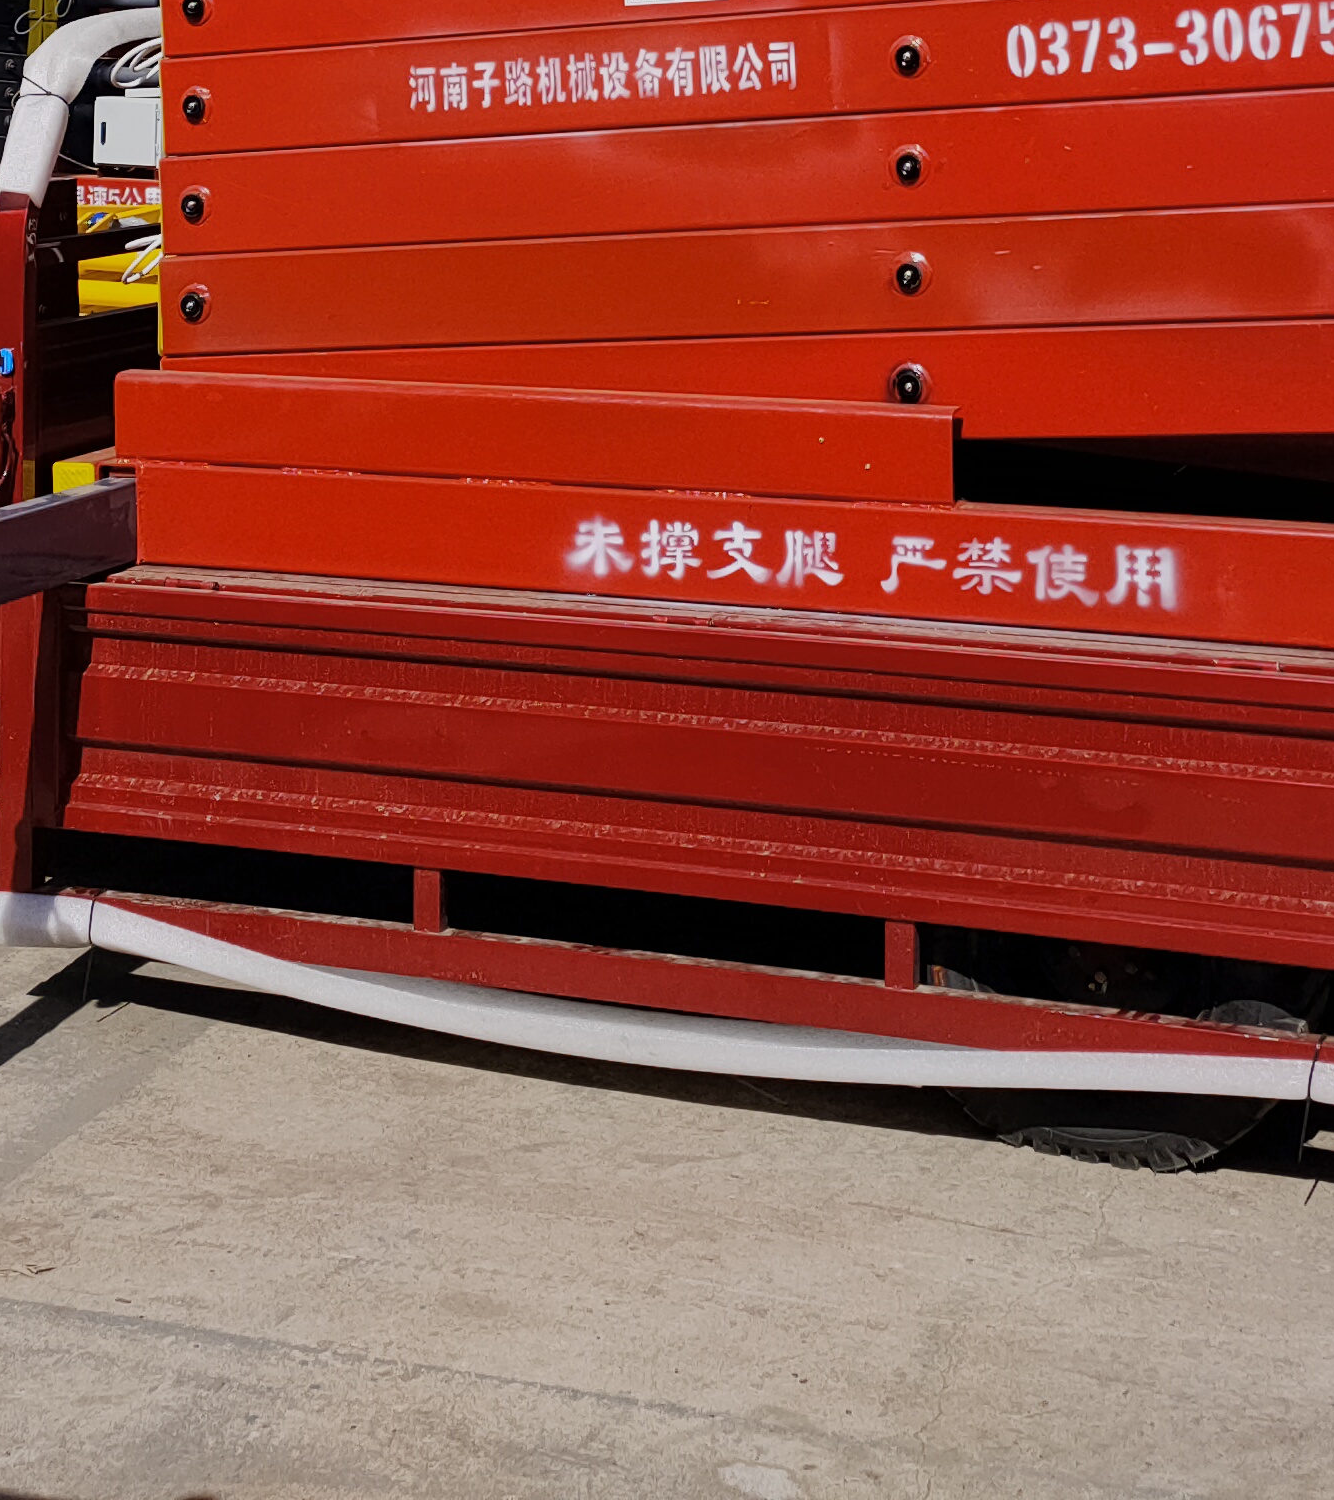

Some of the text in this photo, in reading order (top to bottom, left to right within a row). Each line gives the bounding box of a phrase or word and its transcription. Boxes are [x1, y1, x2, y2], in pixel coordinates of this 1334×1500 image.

[408, 41, 797, 113] 河南子路机械设备有限公司
[568, 515, 1180, 611] 未撑支腿 严禁使用
